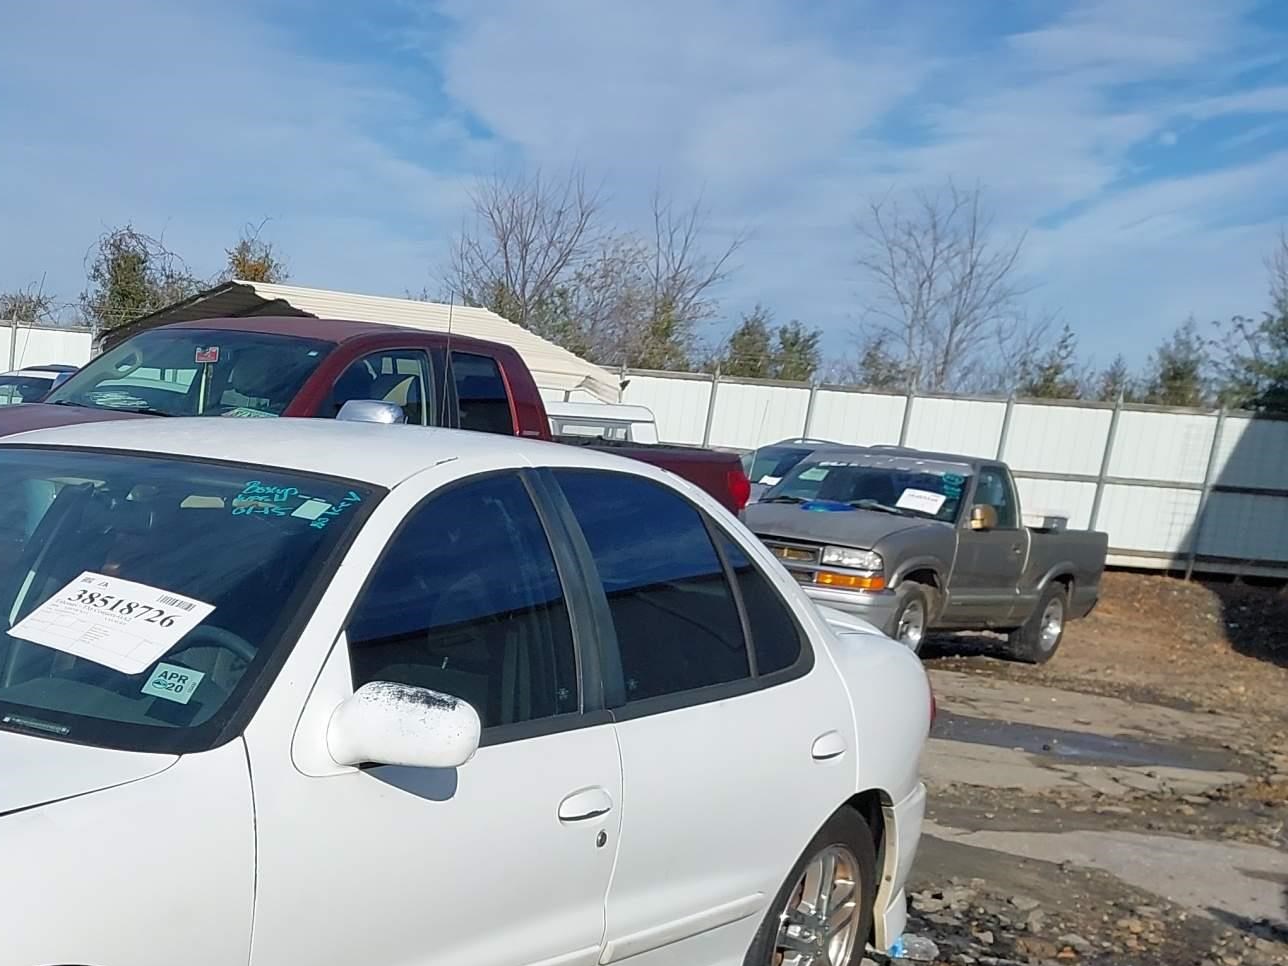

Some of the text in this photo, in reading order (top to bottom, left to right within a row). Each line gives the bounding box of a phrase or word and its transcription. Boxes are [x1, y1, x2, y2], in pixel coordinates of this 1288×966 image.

[66, 588, 177, 628] 38518726
[158, 670, 189, 684] APR
[165, 682, 184, 694] 20
